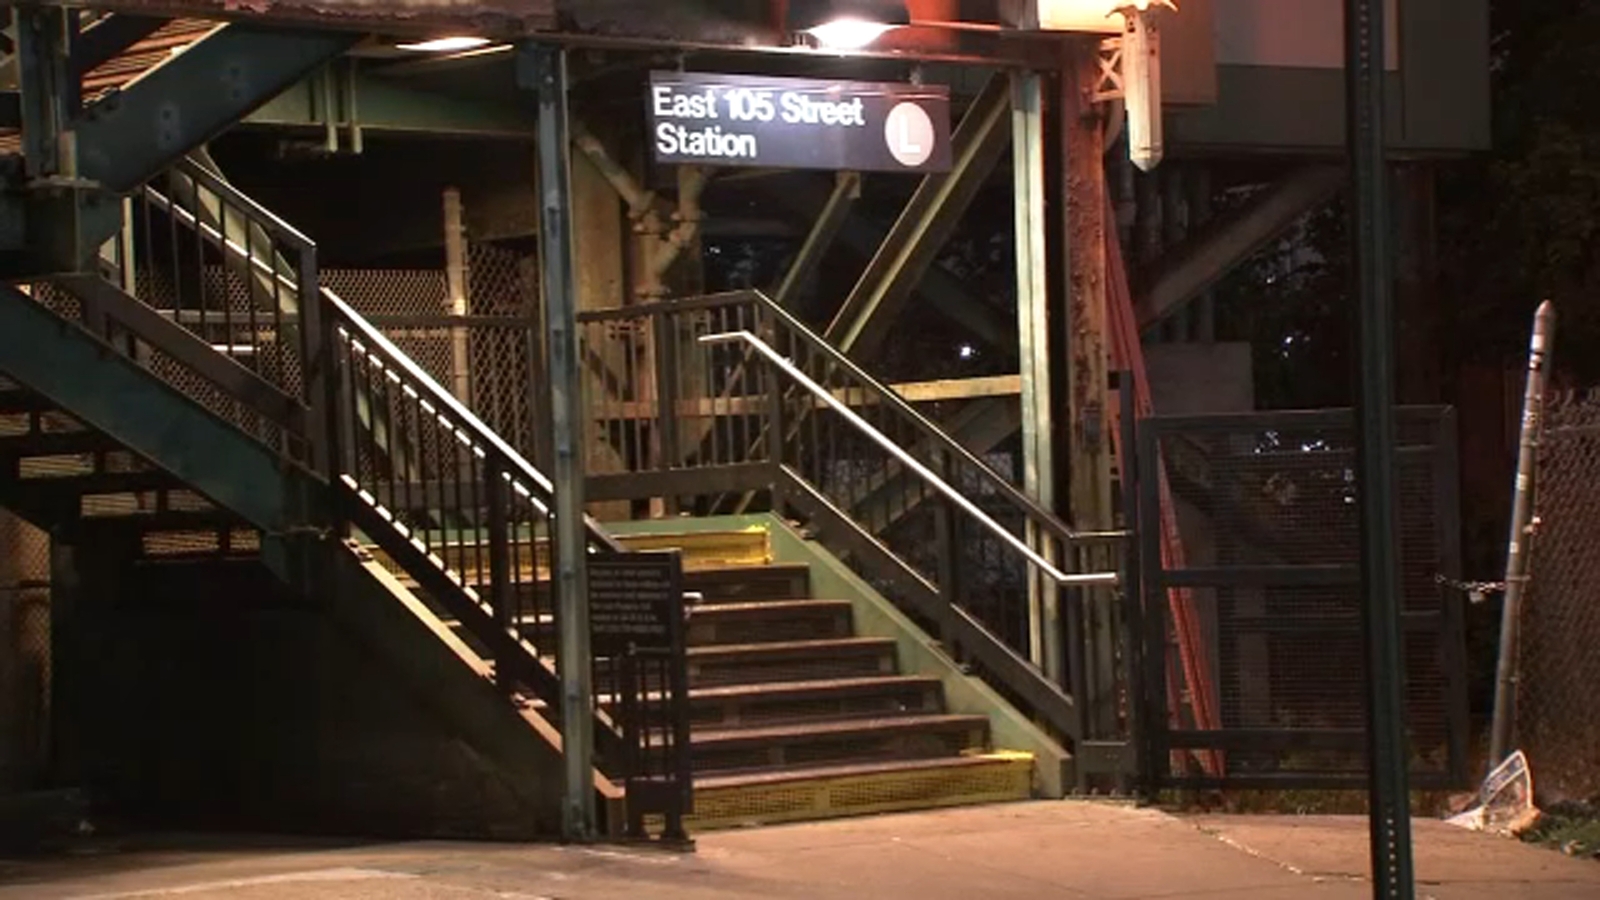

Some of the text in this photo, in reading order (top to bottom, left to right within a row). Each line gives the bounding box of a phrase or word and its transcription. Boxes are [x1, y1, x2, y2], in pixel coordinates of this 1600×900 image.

[653, 86, 865, 126] East 105 Street
[656, 122, 757, 157] Station
[899, 114, 922, 153] L
